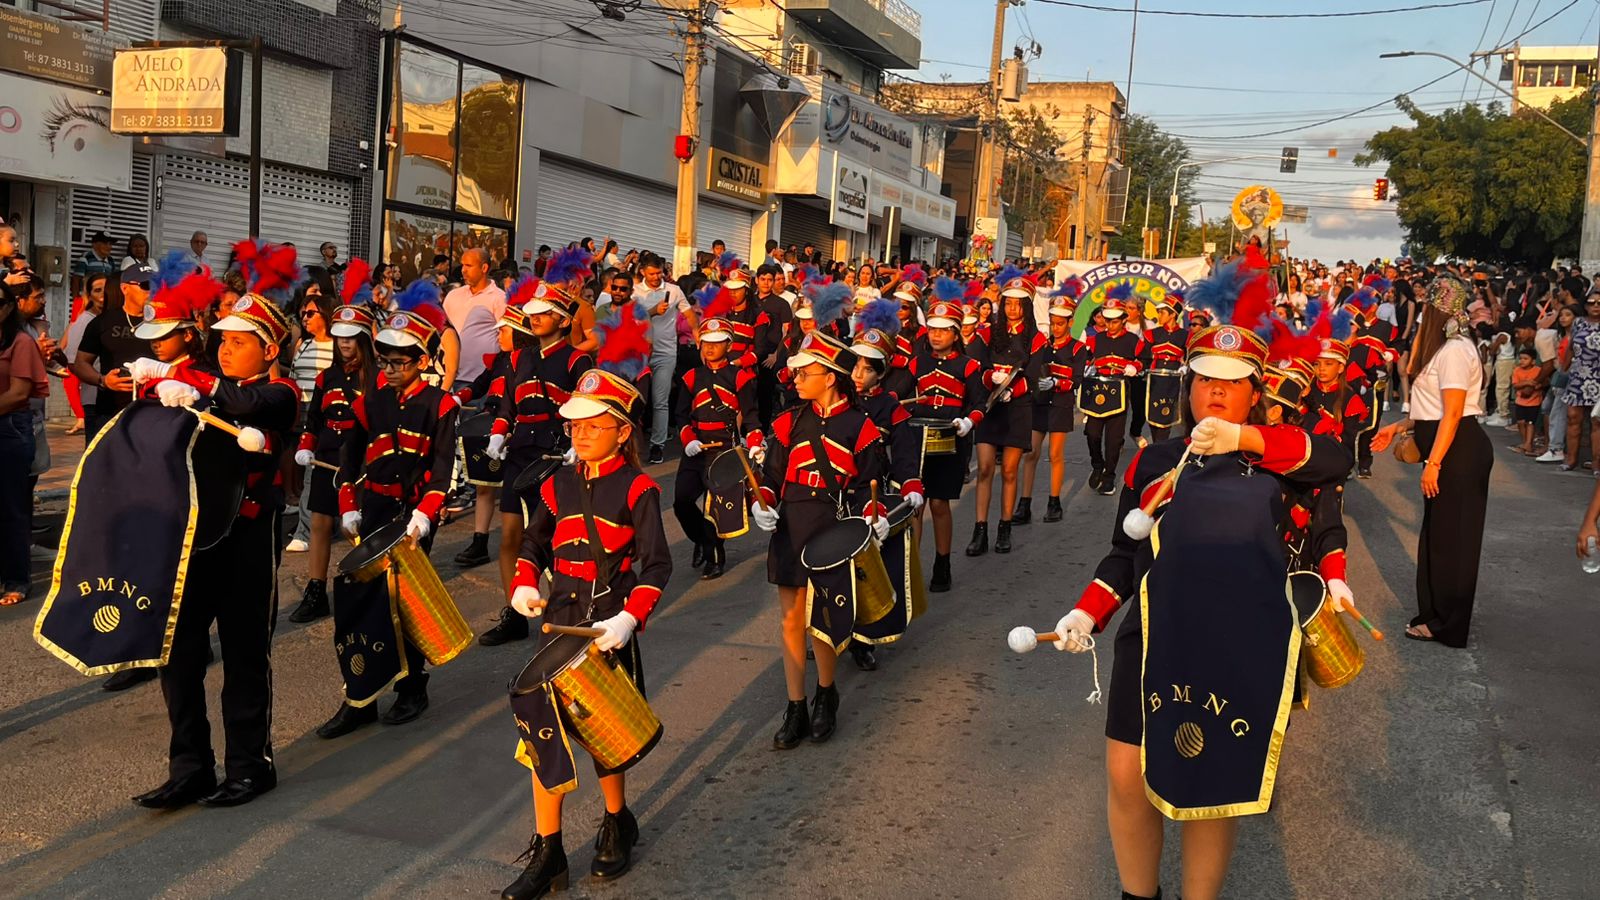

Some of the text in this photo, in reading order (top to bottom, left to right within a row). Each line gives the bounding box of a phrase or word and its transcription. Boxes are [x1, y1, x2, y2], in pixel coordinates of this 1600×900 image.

[24, 50, 36, 62] Tel:
[38, 54, 49, 65] 87
[51, 57, 95, 75] 3831.3113
[122, 114, 214, 127] Tel: 87 3831.3113
[719, 156, 762, 188] CRISTAL
[77, 577, 151, 610] BMNG
[1148, 684, 1250, 738] BMNG
